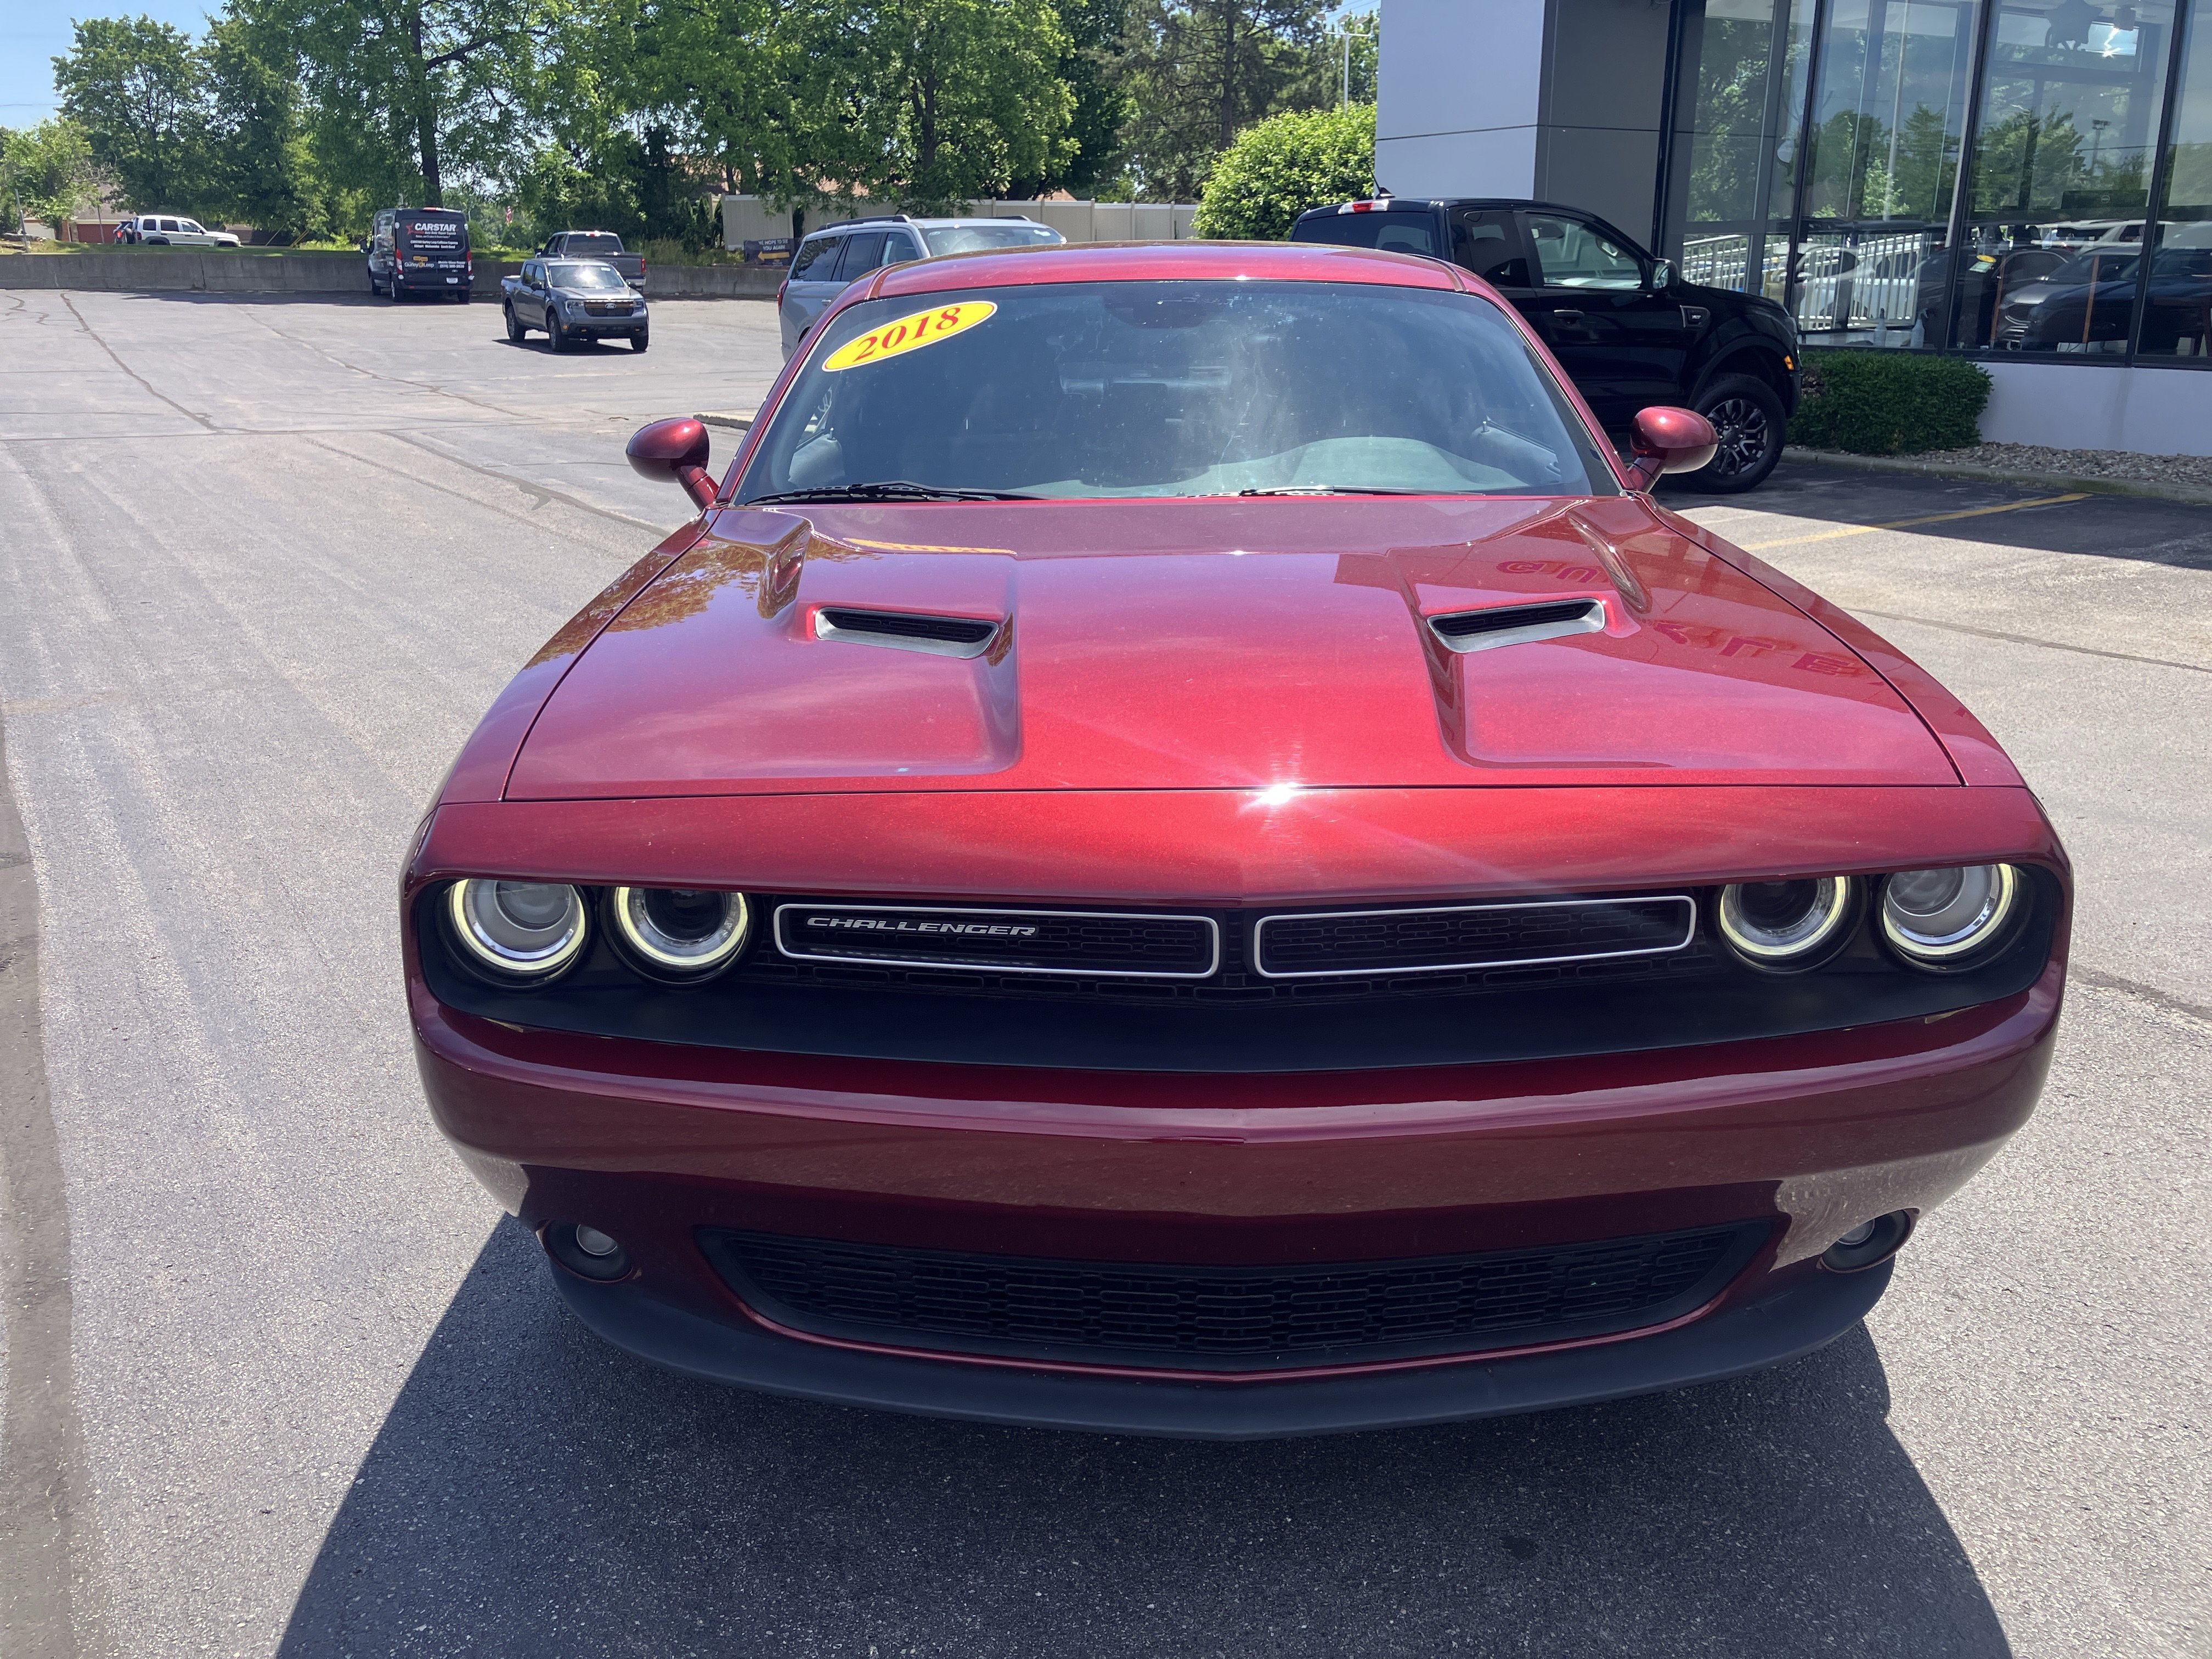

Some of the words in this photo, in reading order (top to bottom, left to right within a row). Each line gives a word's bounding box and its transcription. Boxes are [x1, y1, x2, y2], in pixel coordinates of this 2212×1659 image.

[415, 223, 456, 232] CARSTAR
[852, 307, 961, 363] 2018
[807, 917, 1036, 936] CHALLENGER
